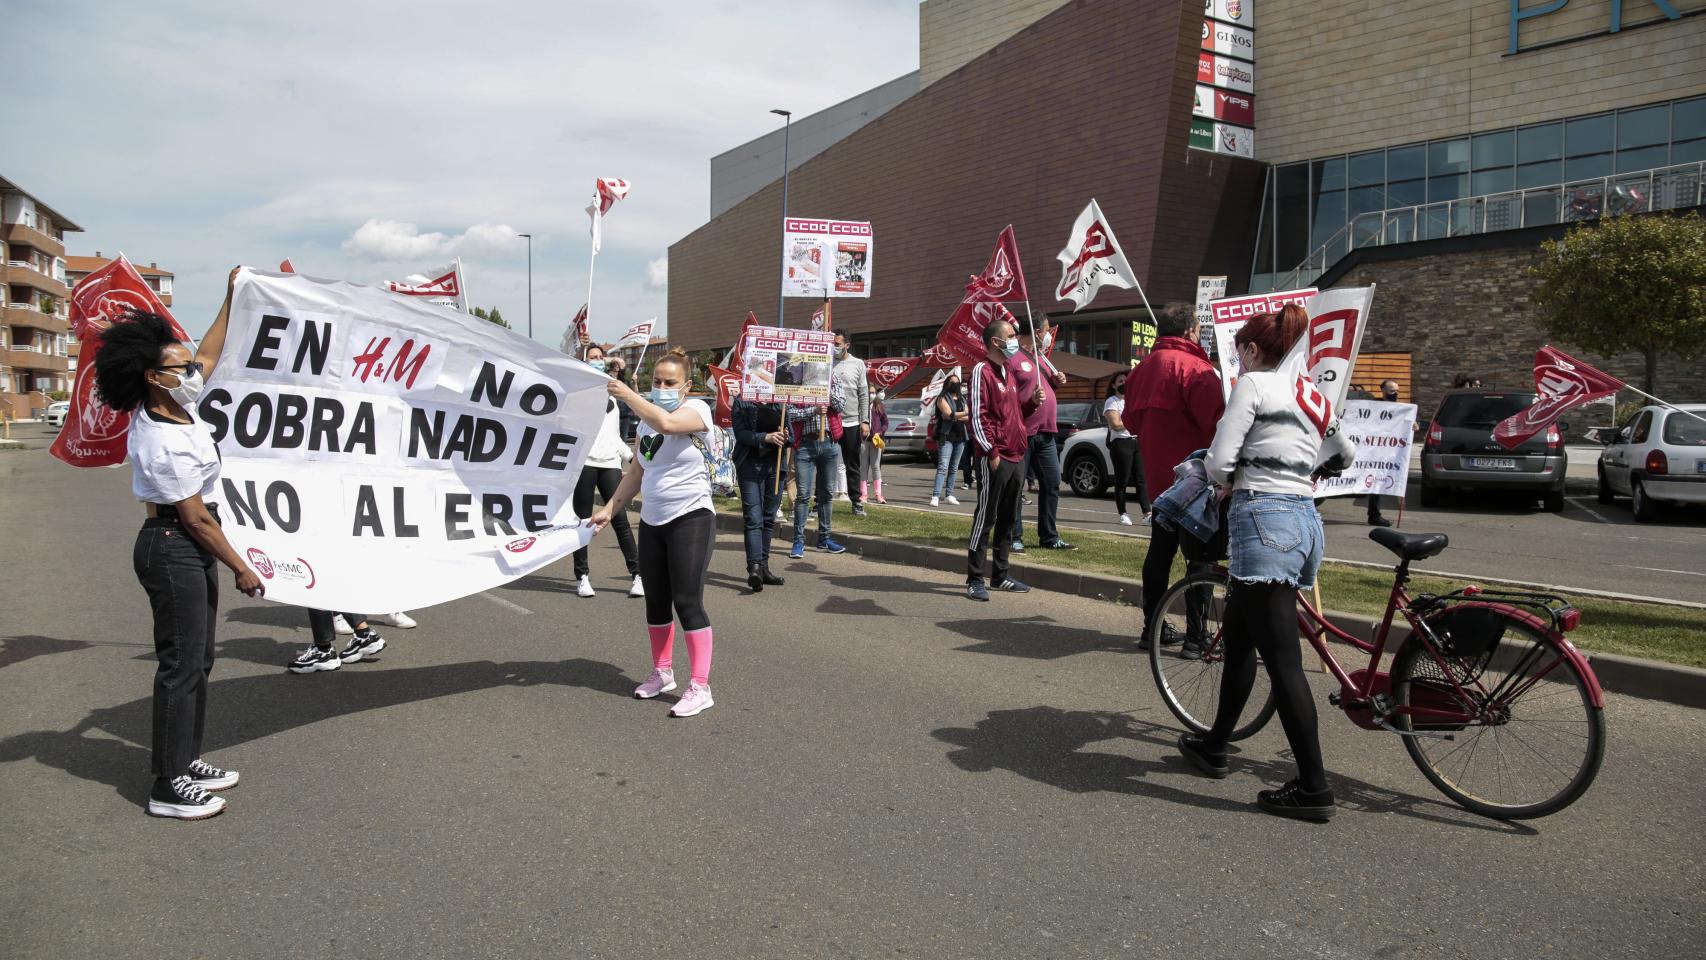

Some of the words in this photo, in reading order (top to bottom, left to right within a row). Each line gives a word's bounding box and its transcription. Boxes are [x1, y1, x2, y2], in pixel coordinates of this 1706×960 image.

[1216, 31, 1252, 48] GINOS
[1217, 64, 1252, 83] telepizza
[1219, 93, 1249, 108] VIPS
[789, 222, 828, 231] CCOO
[832, 225, 869, 234] CCOO
[1217, 303, 1266, 319] CCOO
[757, 340, 786, 349] CCOO
[799, 344, 827, 352] CCOO
[246, 314, 332, 375] EN
[352, 336, 431, 390] H&M
[470, 361, 558, 416] NO
[1357, 408, 1371, 419] NO
[1379, 409, 1394, 420] OS
[197, 388, 376, 455] SOBRA
[408, 407, 578, 470] NADIE
[1353, 460, 1400, 470] NUESTROS
[221, 478, 301, 534] NO
[352, 484, 419, 537] AL
[445, 492, 553, 540] ERE
